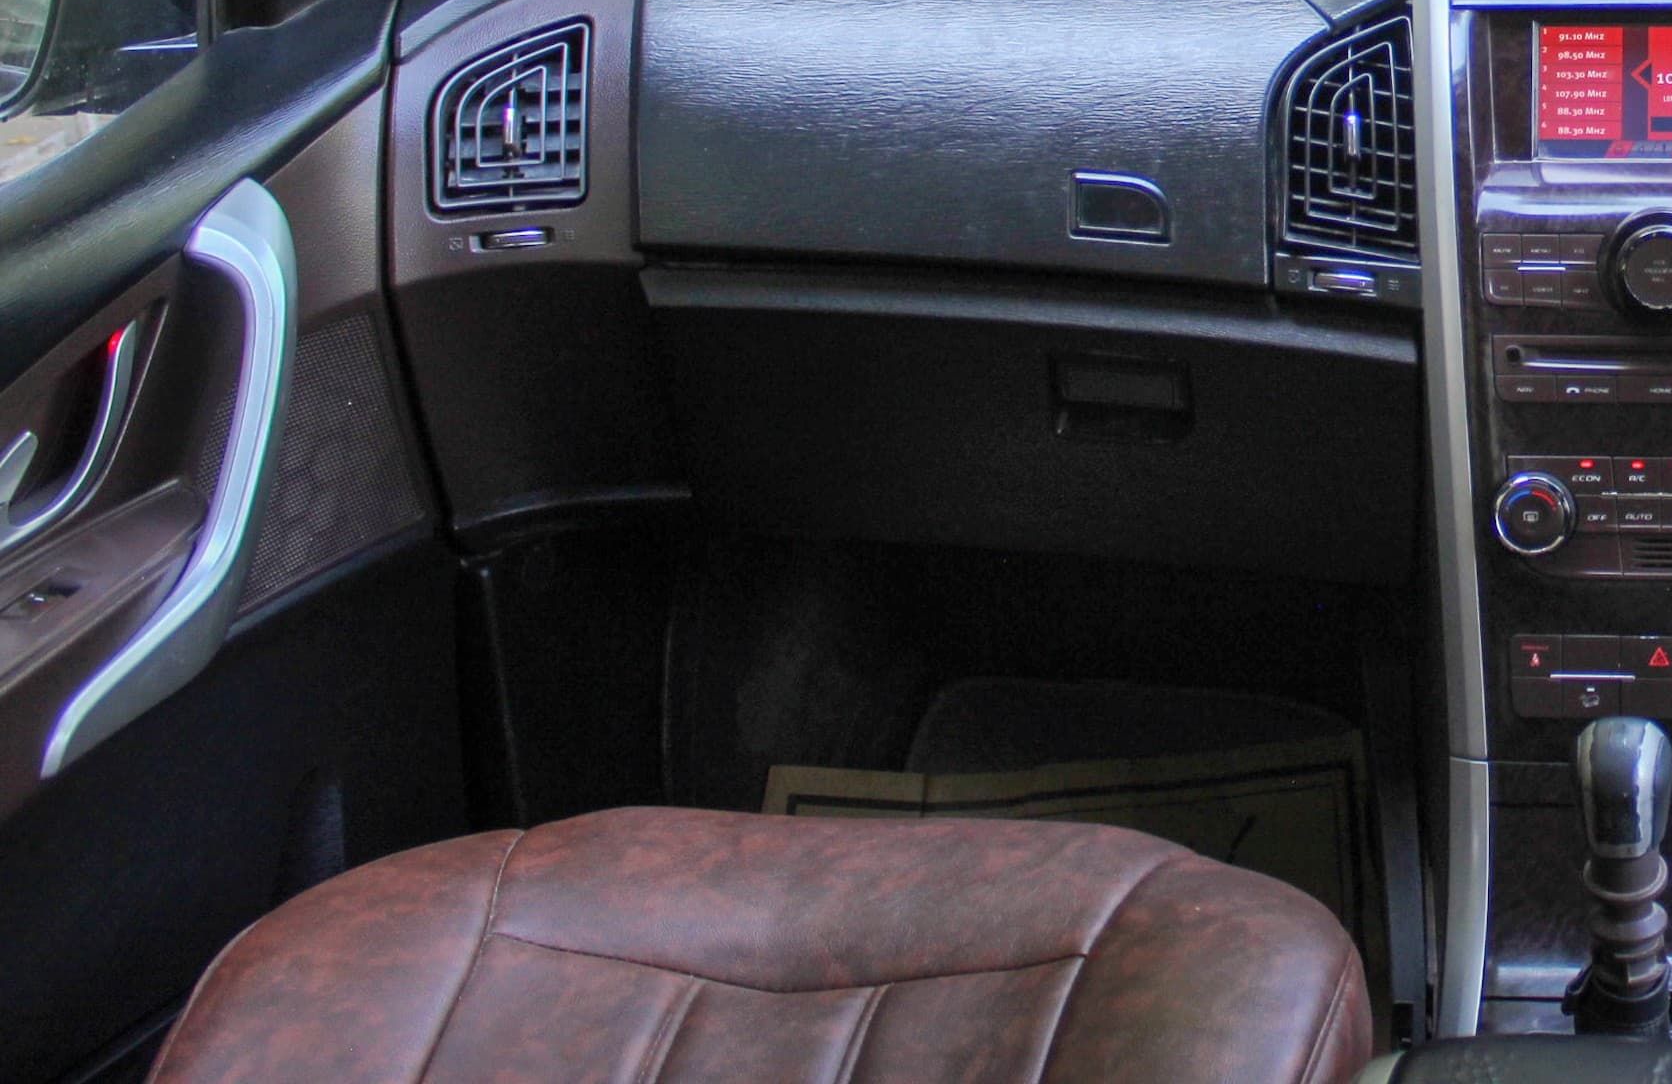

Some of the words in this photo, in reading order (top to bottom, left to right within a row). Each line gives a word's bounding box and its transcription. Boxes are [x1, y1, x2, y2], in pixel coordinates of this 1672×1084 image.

[1558, 32, 1582, 42] 91.10
[1557, 51, 1583, 61] 98.50
[1556, 70, 1585, 80] 103.30
[1556, 90, 1585, 100] 107.90
[1557, 107, 1583, 117] 88.30
[1558, 125, 1583, 135] 88.30
[1516, 386, 1535, 394] NAV
[1584, 387, 1610, 395] PHONE
[1571, 474, 1601, 483] ECON
[1628, 474, 1646, 483] A/C
[1587, 514, 1608, 522] OFF
[1625, 513, 1653, 522] AUTO
